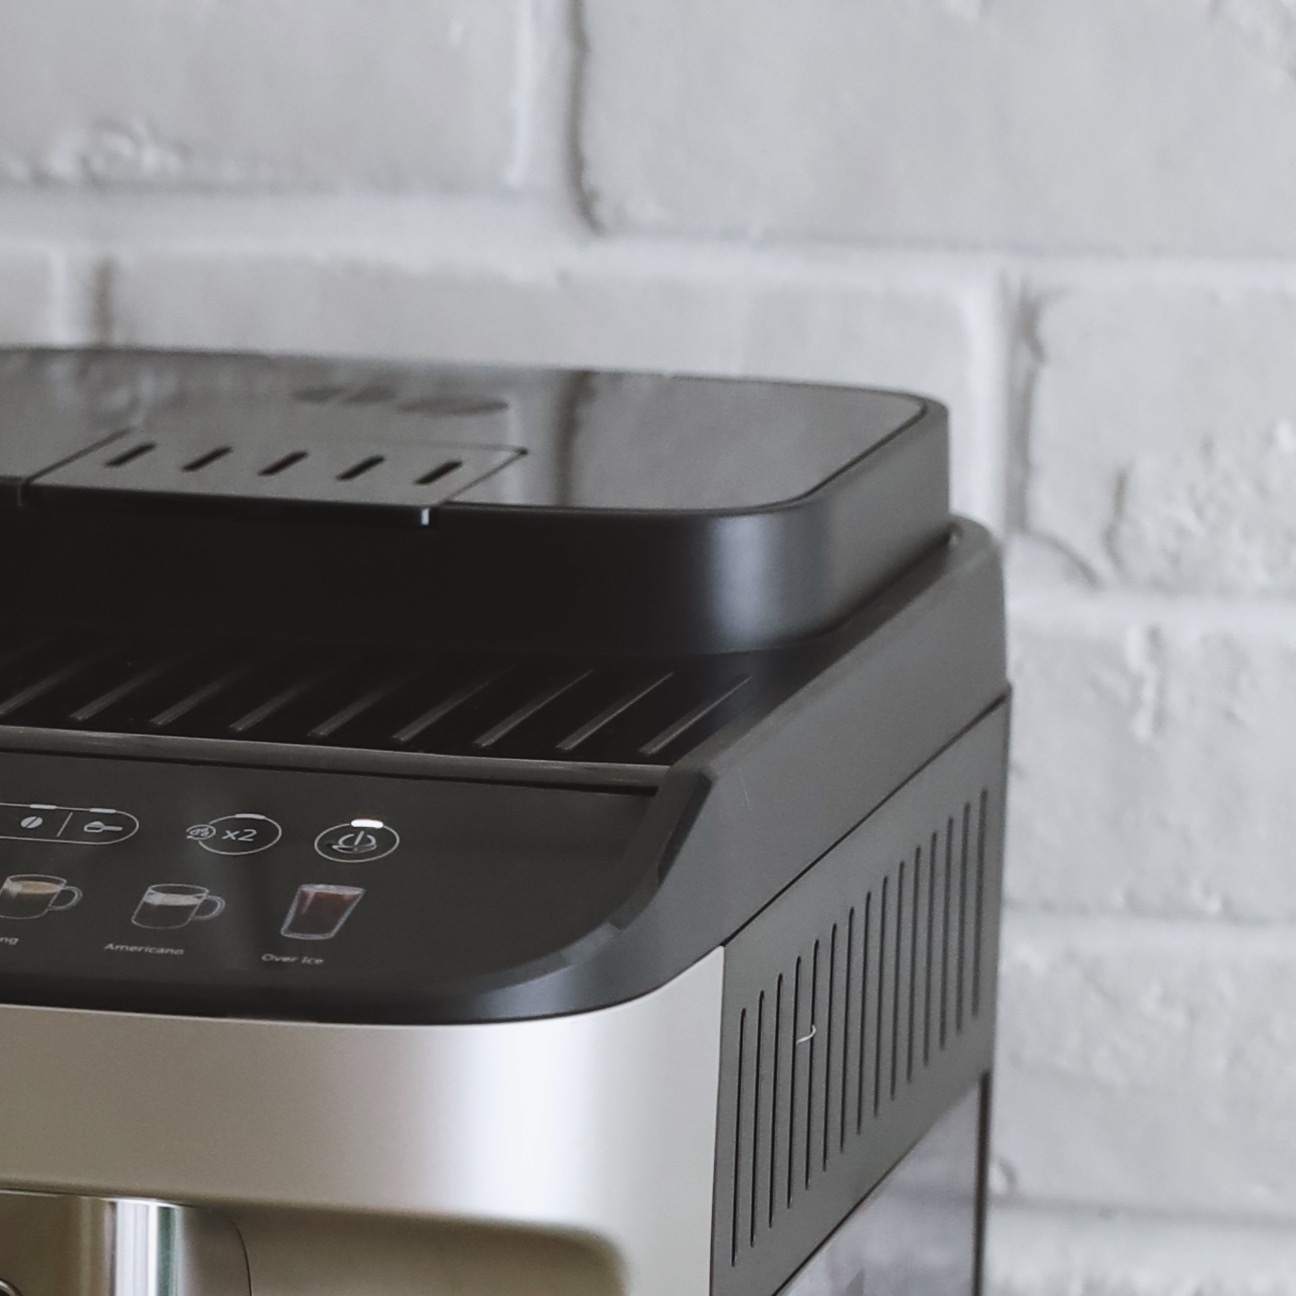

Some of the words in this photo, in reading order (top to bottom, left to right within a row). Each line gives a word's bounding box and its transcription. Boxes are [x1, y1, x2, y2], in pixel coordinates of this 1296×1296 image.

[221, 829, 258, 842] x2
[104, 942, 185, 956] Americano
[260, 953, 299, 963] Over
